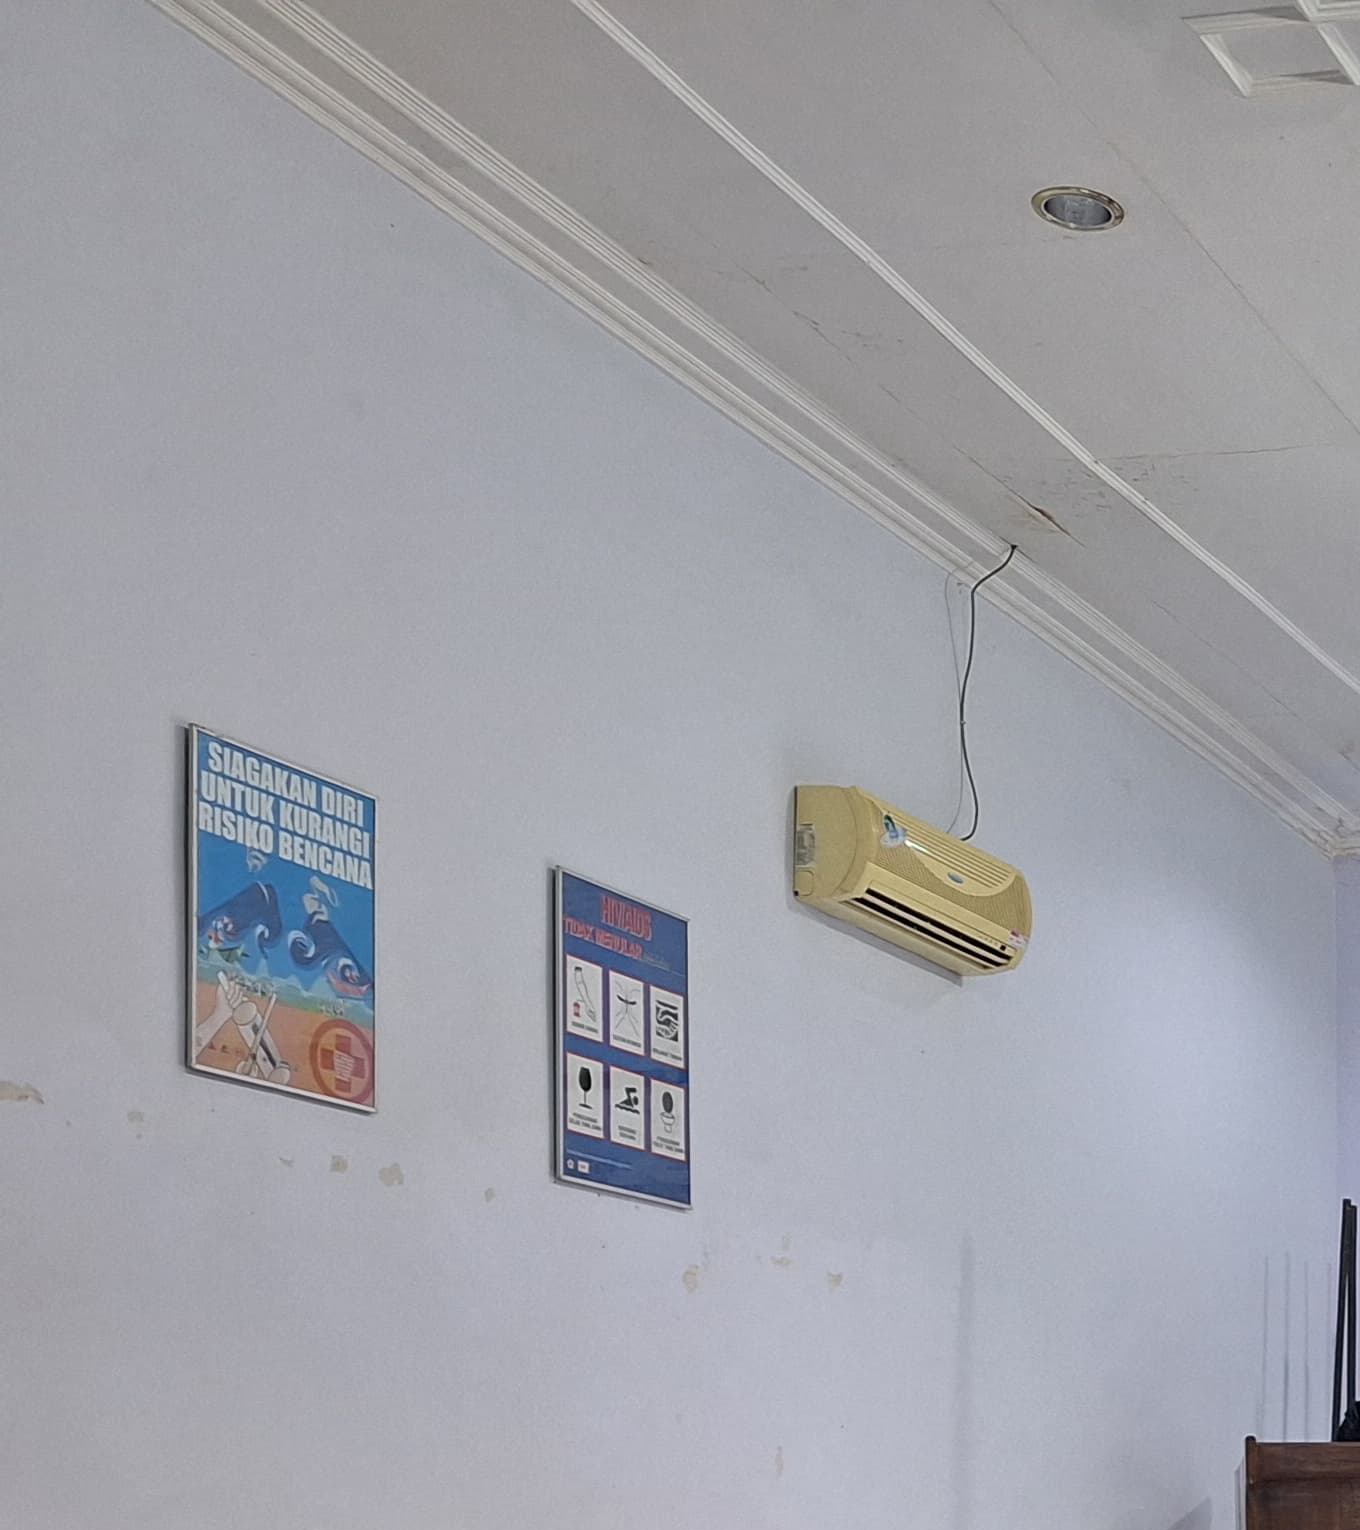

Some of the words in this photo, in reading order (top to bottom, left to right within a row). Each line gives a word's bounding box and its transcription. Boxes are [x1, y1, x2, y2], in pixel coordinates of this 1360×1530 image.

[201, 770, 275, 825] UNTUK
[279, 799, 370, 859] KURANGI
[208, 741, 317, 809] SIAGAKAN
[322, 785, 365, 828] DIRI
[199, 800, 274, 854] RISIKO
[278, 830, 373, 890] BENCANA
